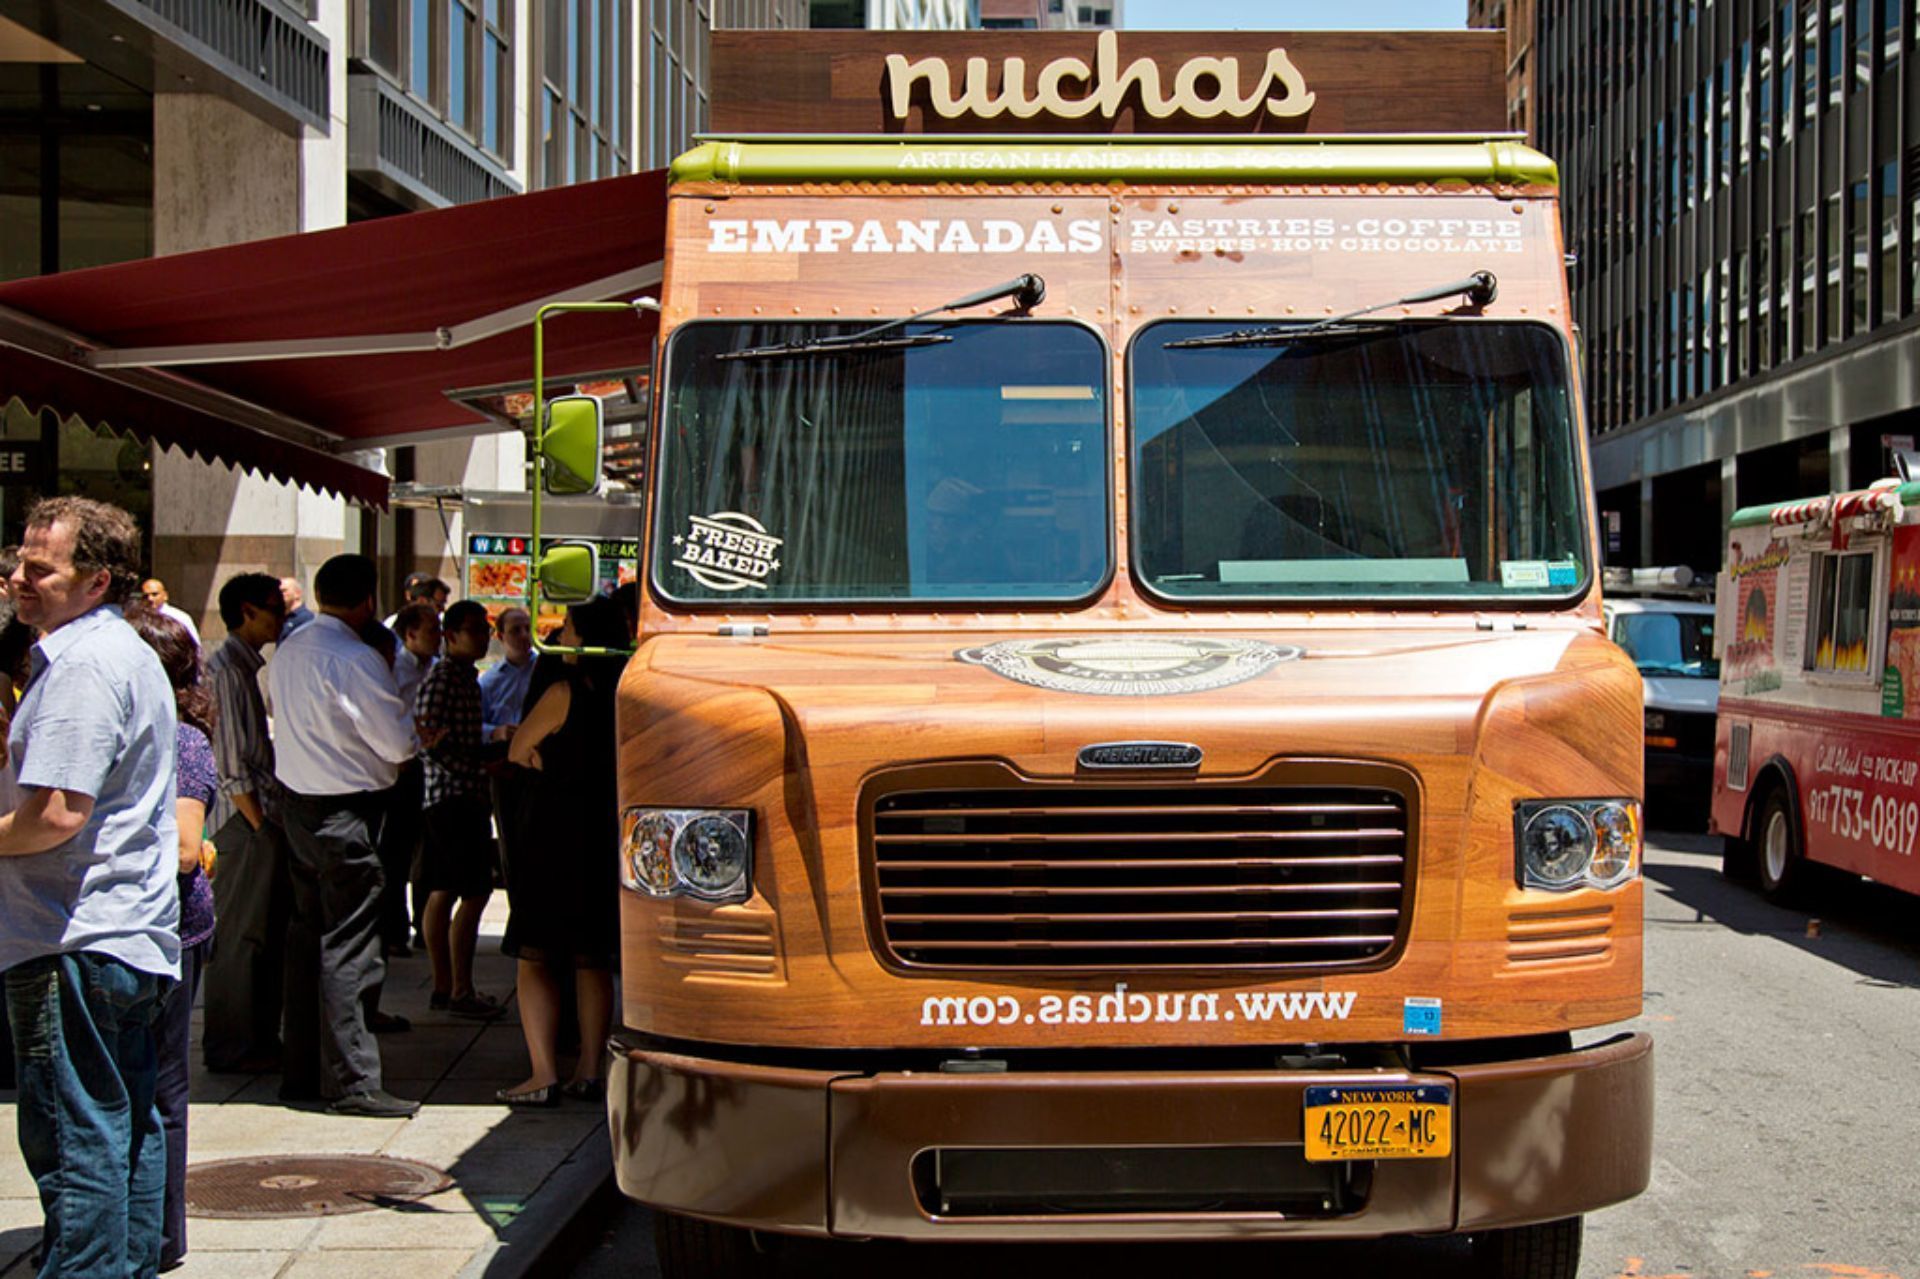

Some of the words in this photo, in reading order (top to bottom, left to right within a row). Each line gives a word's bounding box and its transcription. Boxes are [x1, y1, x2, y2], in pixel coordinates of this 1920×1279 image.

[884, 29, 1316, 119] nuchas
[898, 152, 1030, 169] ARTISAN
[707, 219, 1101, 254] EMPANADAS
[1130, 219, 1336, 237] PASTRIES
[1356, 219, 1522, 237] COFFEE
[1339, 238, 1524, 253] CHOCOLATE
[687, 523, 778, 560] FRESH
[682, 543, 770, 577] BAKED
[1874, 756, 1918, 786] PICK-UP
[1808, 788, 1829, 824] 917
[1830, 785, 1919, 856] 753-0819
[1341, 1091, 1376, 1103] NEW
[1379, 1091, 1416, 1103] YORK
